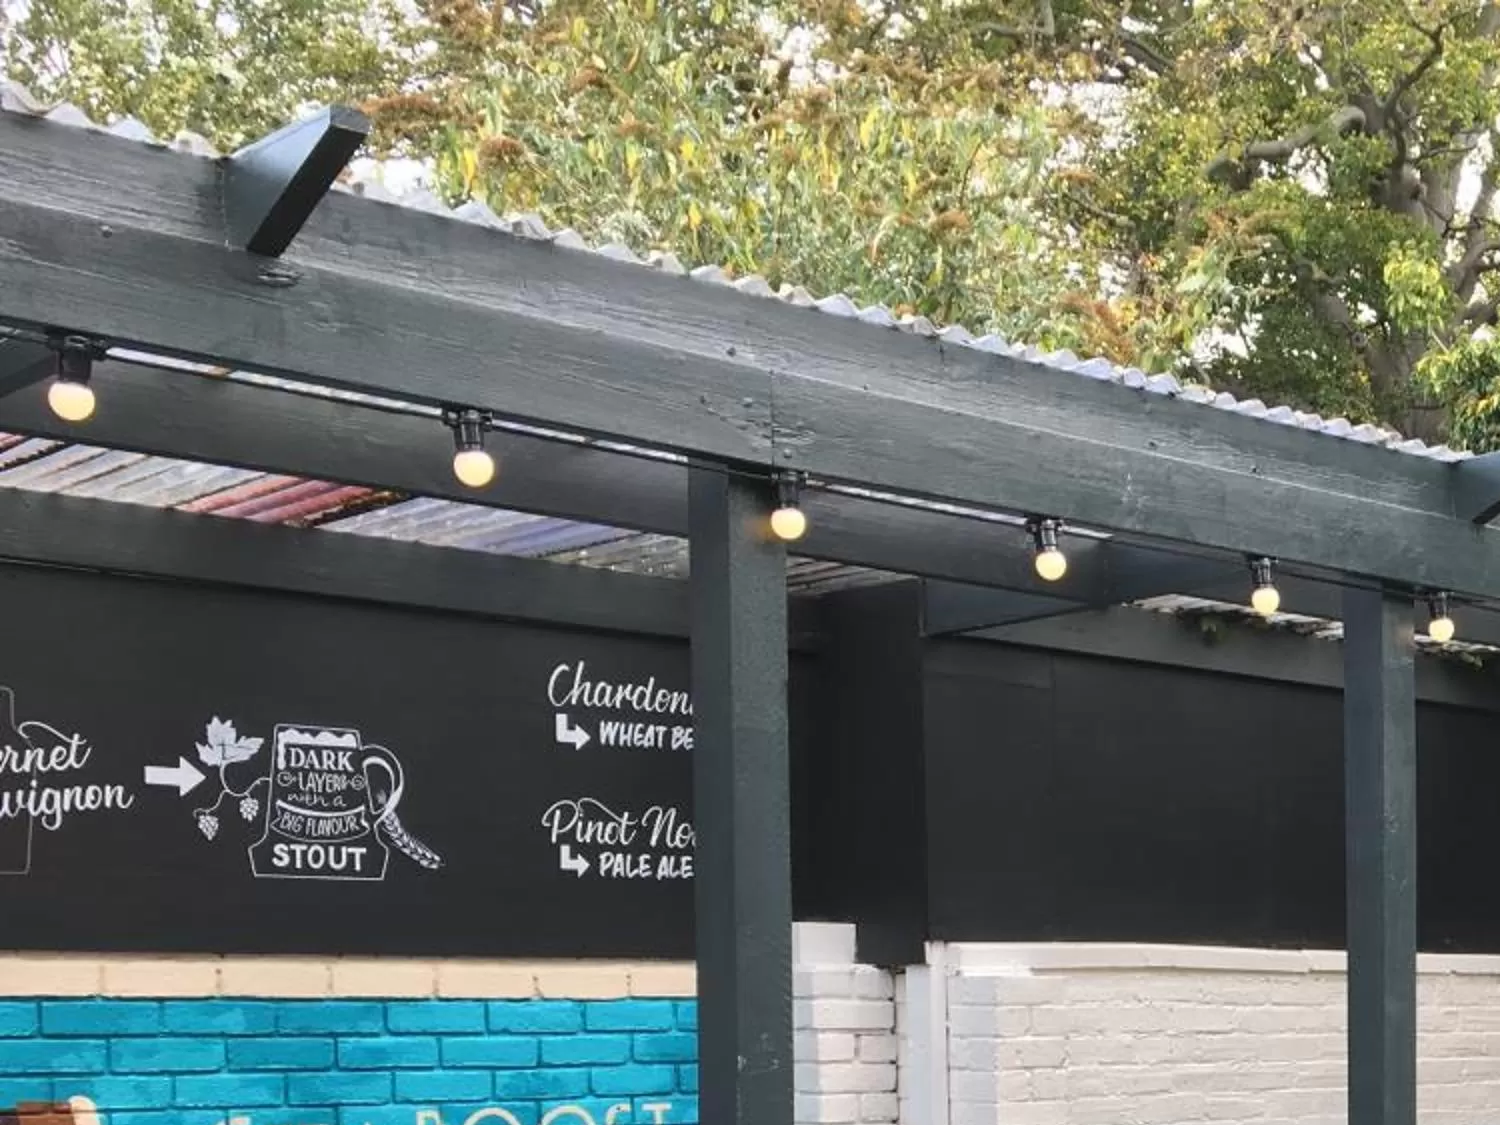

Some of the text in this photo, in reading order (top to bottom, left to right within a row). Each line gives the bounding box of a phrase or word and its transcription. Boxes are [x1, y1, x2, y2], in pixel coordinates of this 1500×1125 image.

[548, 660, 693, 715] Chardon
[0, 720, 92, 773] rnet
[600, 719, 694, 750] WHEAT BE
[289, 746, 354, 772] DARK
[0, 779, 134, 831] vignon
[280, 811, 360, 837] BIG FLAVOUR
[541, 797, 638, 845] Pinot
[272, 843, 367, 872] STOUT
[599, 851, 695, 881] PALE ALE
